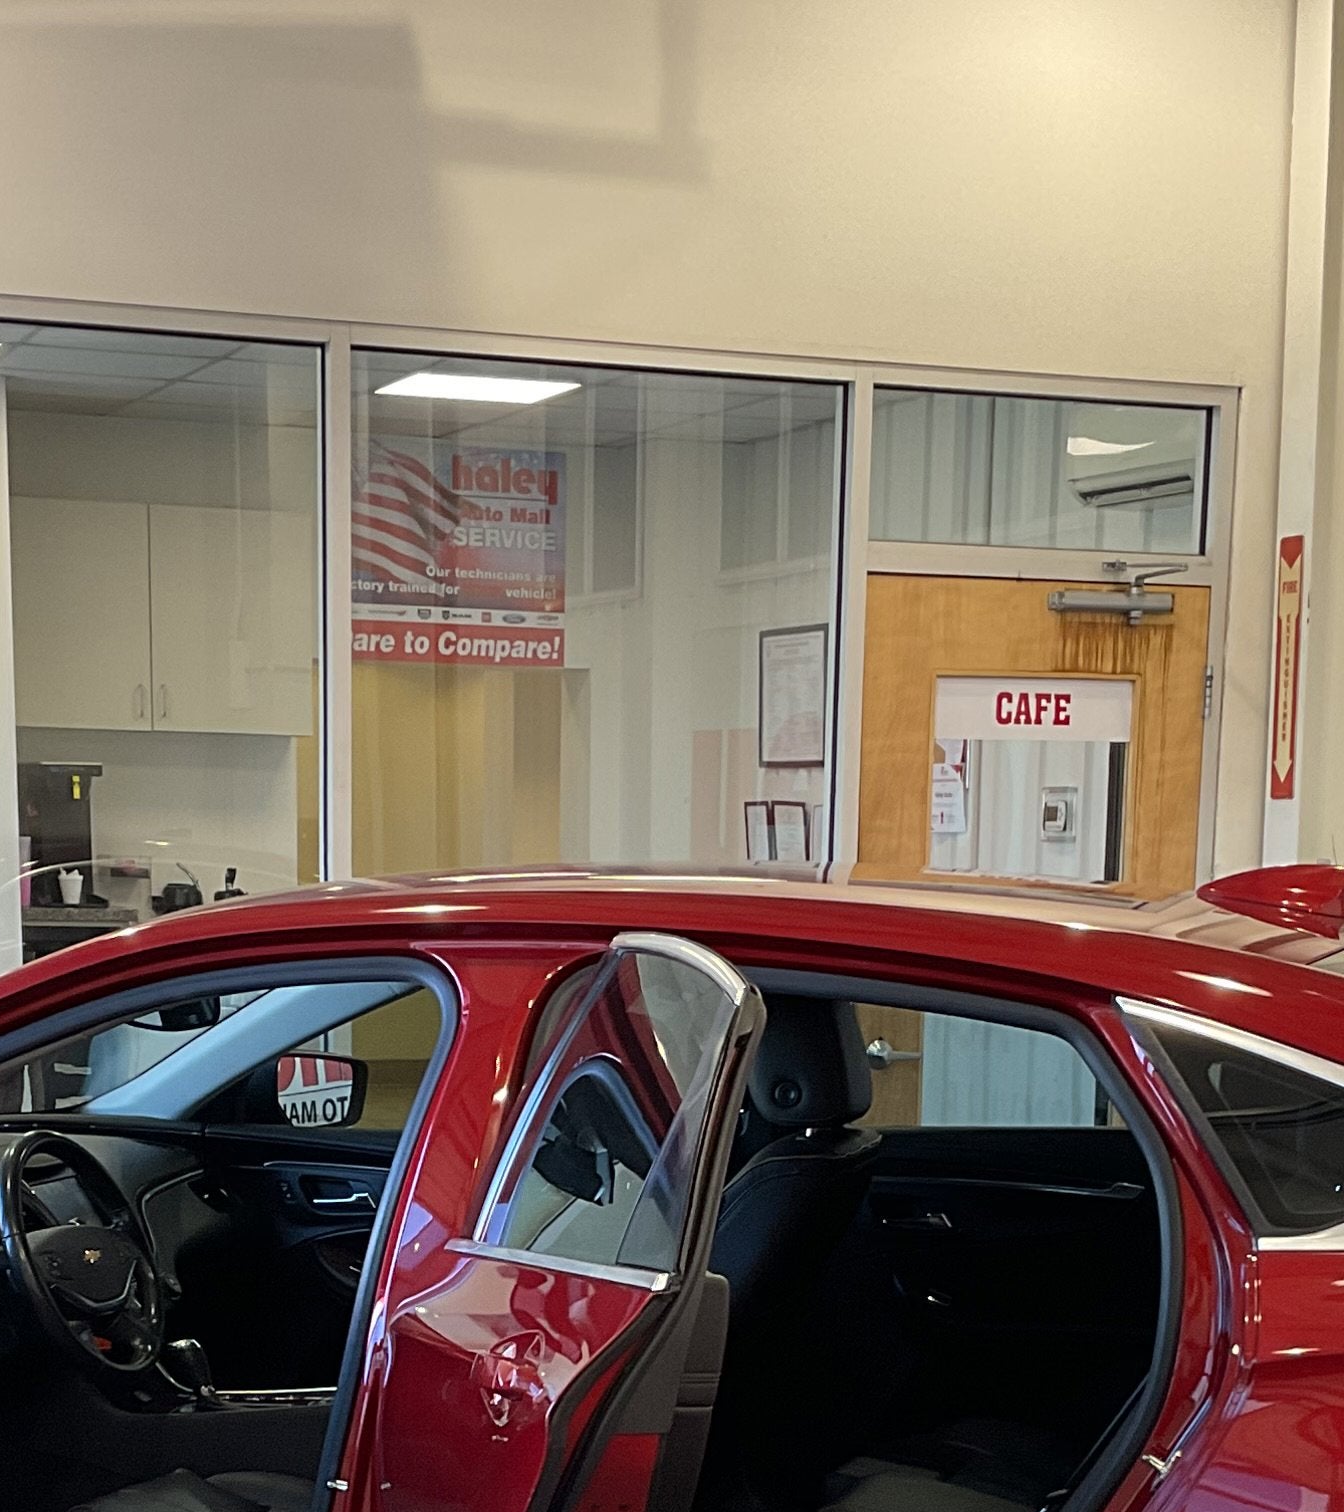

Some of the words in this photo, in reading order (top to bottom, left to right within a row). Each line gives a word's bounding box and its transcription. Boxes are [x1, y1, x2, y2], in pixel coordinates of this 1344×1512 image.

[451, 453, 559, 505] haley
[459, 506, 503, 522] Auto
[510, 508, 551, 524] Mall
[453, 526, 556, 550] SERVICE
[425, 565, 451, 577] Our
[455, 566, 531, 581] technicians
[536, 572, 556, 582] are
[388, 580, 436, 594] trained
[438, 582, 461, 598] for
[1282, 580, 1298, 594] FIRE
[351, 631, 396, 654] are
[404, 630, 430, 654] to
[438, 631, 561, 663] Compare!
[995, 691, 1072, 727] CAFE
